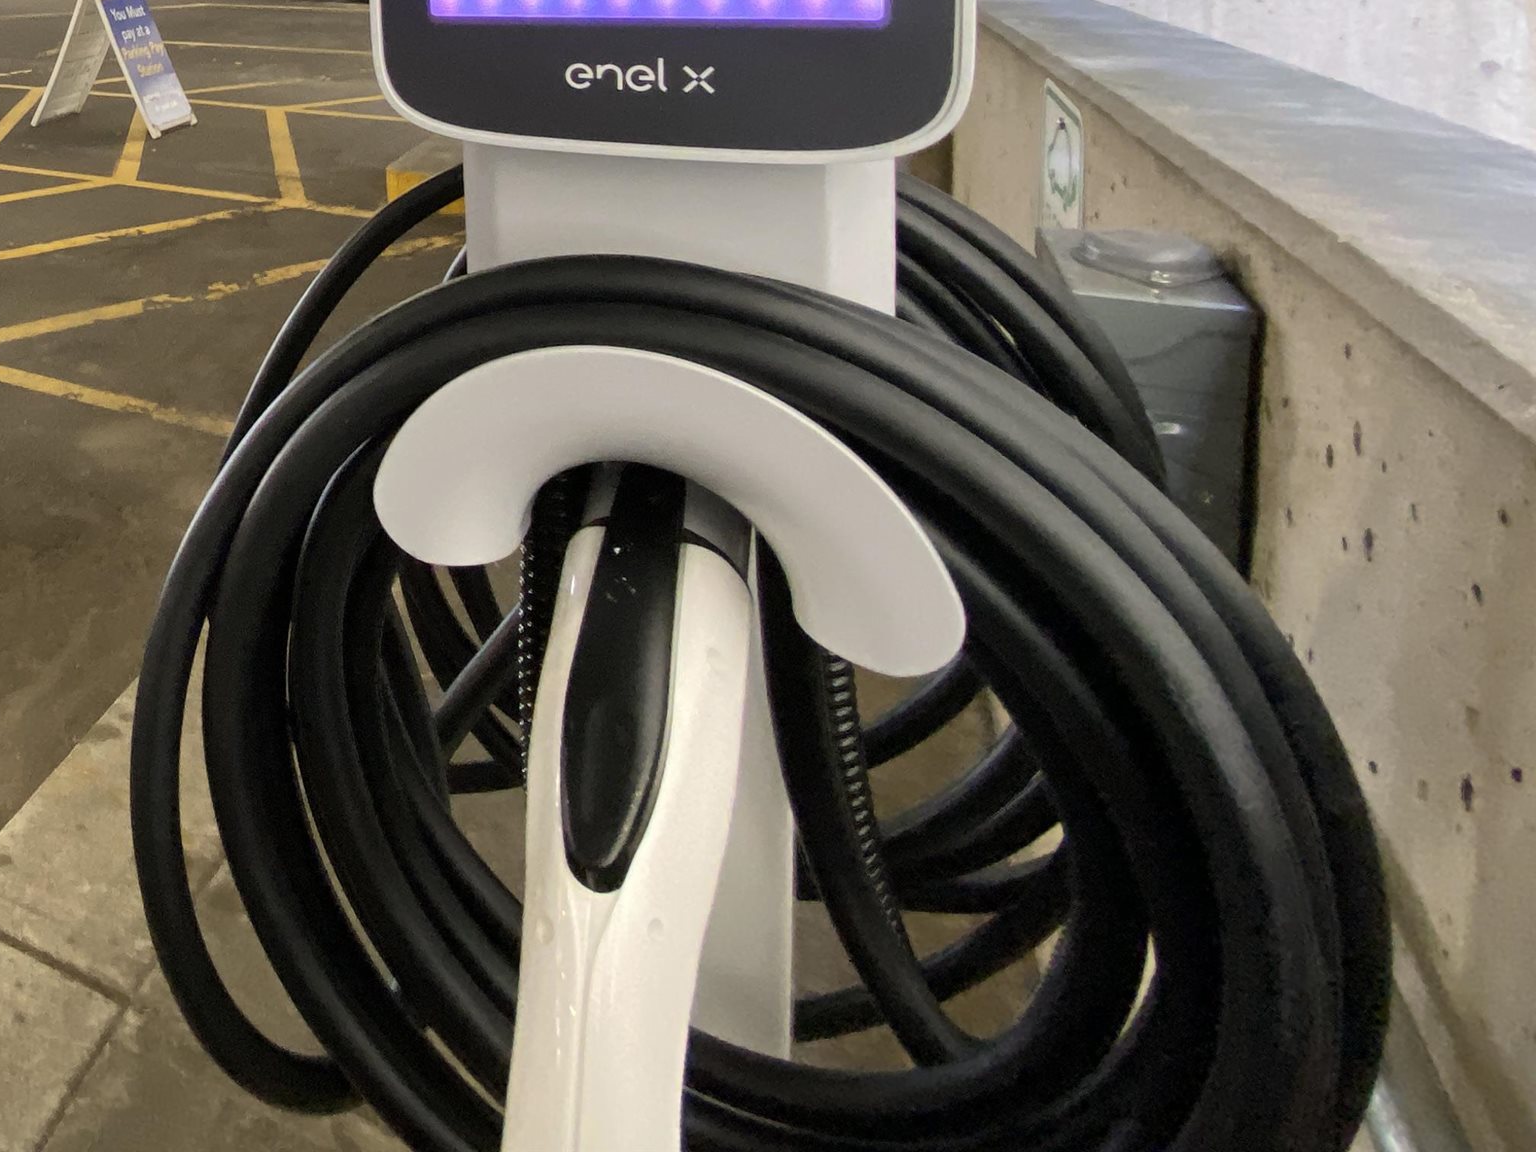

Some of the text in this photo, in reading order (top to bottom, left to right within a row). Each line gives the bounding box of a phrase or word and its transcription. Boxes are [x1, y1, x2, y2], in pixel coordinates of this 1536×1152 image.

[109, 4, 146, 21] You Must
[121, 25, 151, 42] pay at a
[565, 57, 668, 93] enel
